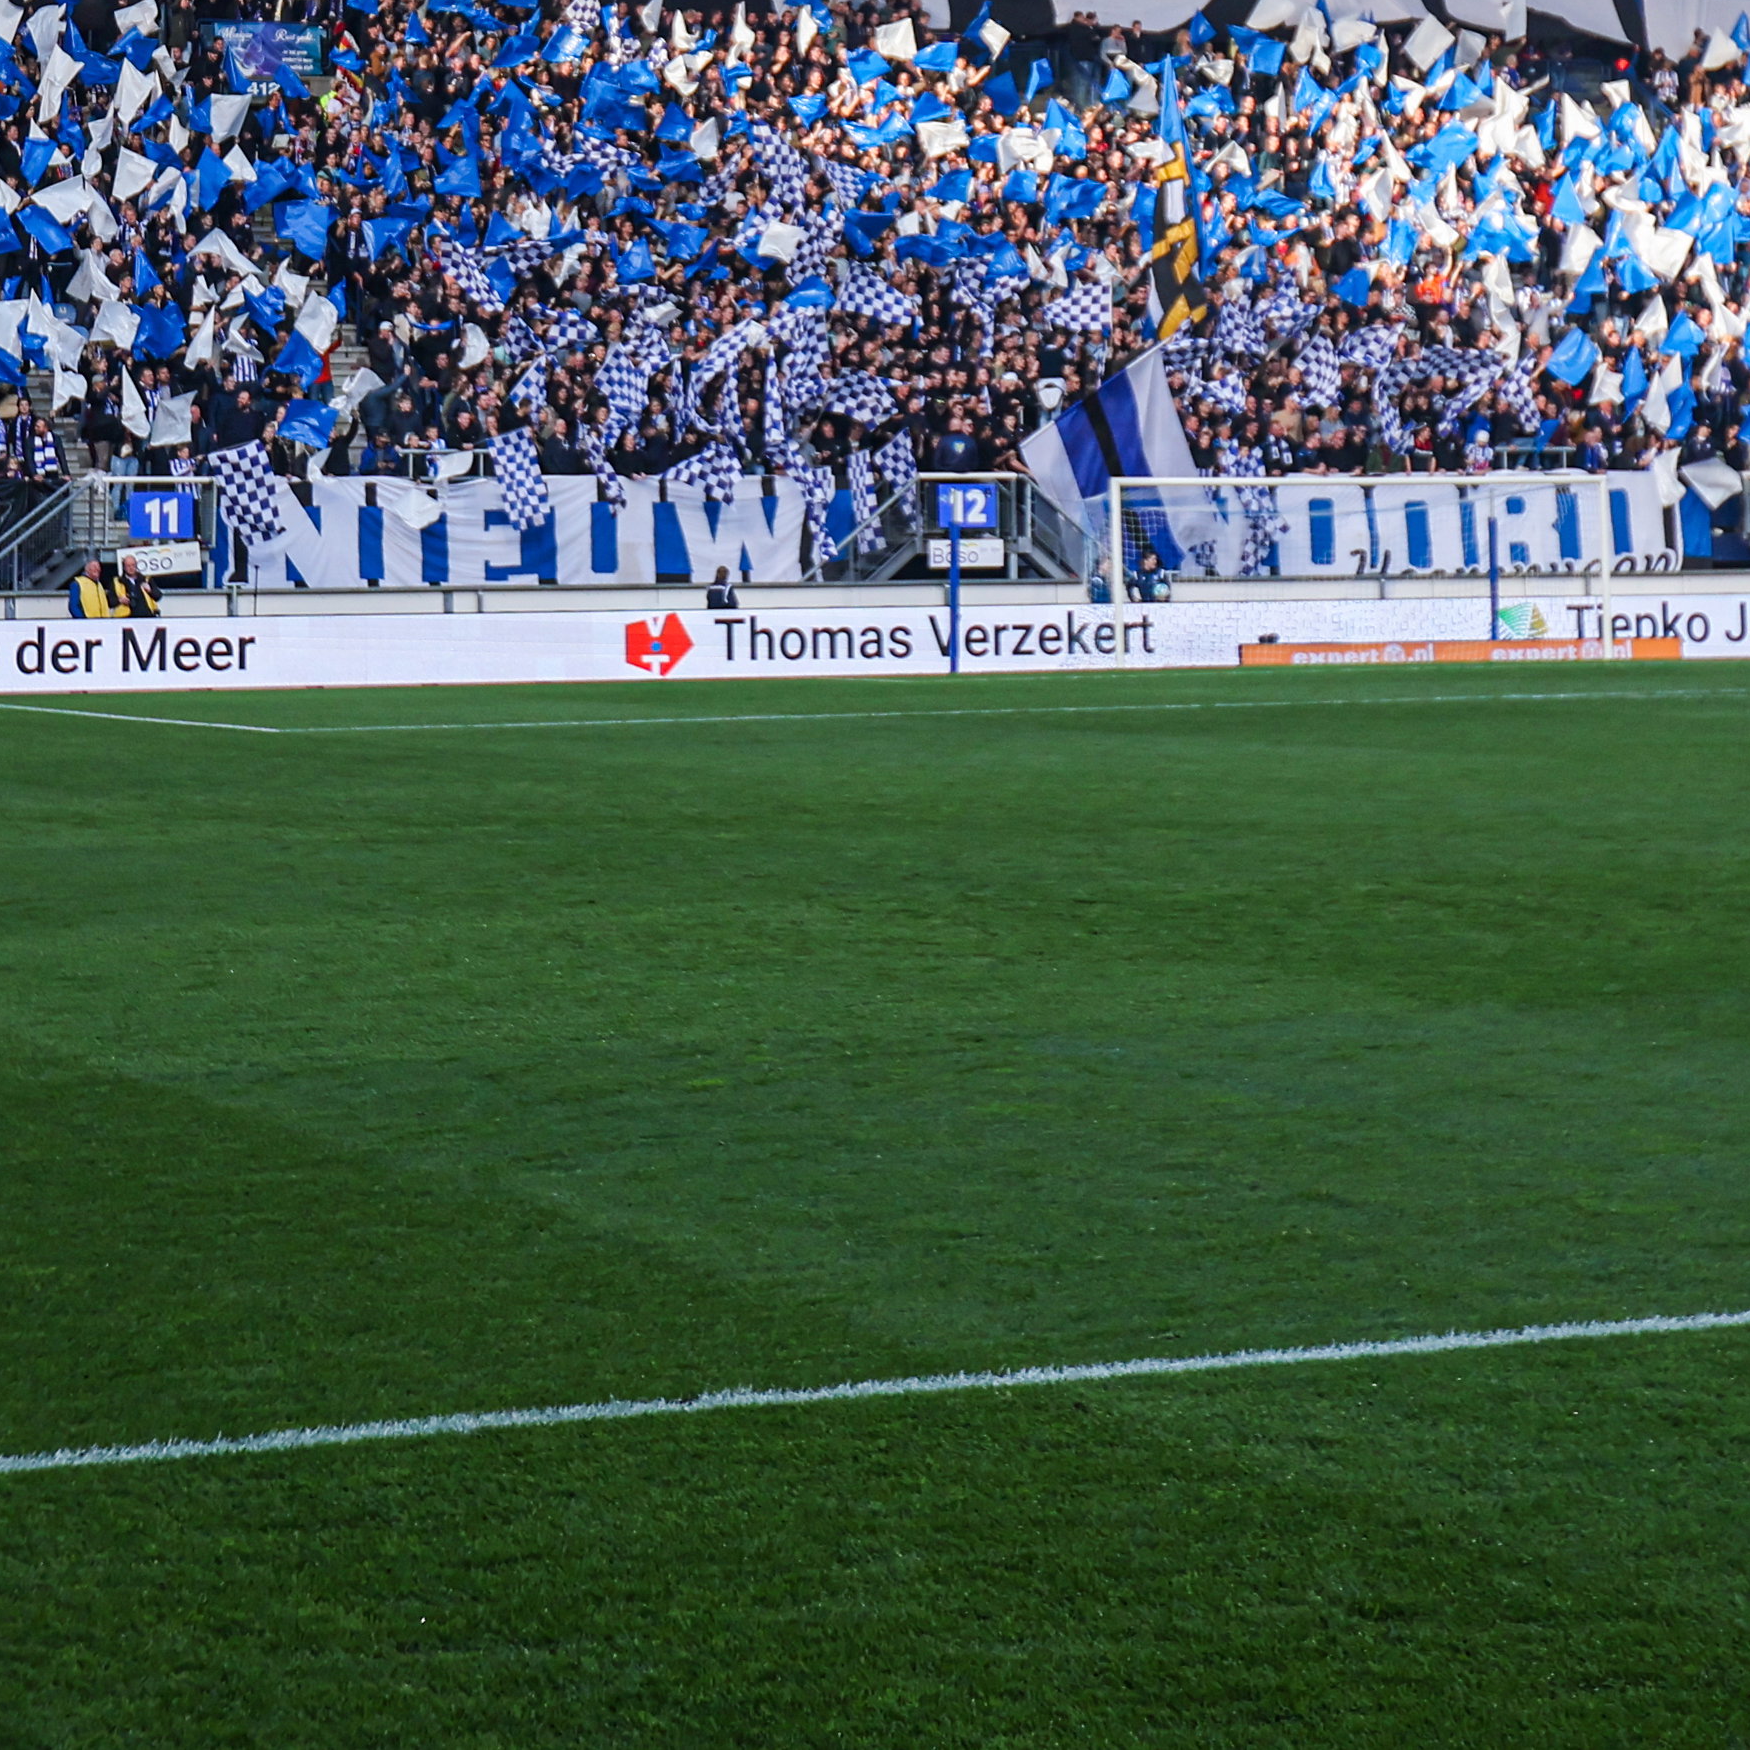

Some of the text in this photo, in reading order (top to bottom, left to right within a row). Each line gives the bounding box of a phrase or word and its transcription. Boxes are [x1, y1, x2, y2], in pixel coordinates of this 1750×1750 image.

[144, 496, 179, 535] 11
[950, 487, 987, 523] 12
[227, 474, 823, 587] NIEUW
[15, 626, 103, 674] der
[120, 626, 257, 673] Meer
[714, 614, 913, 662] Thomas
